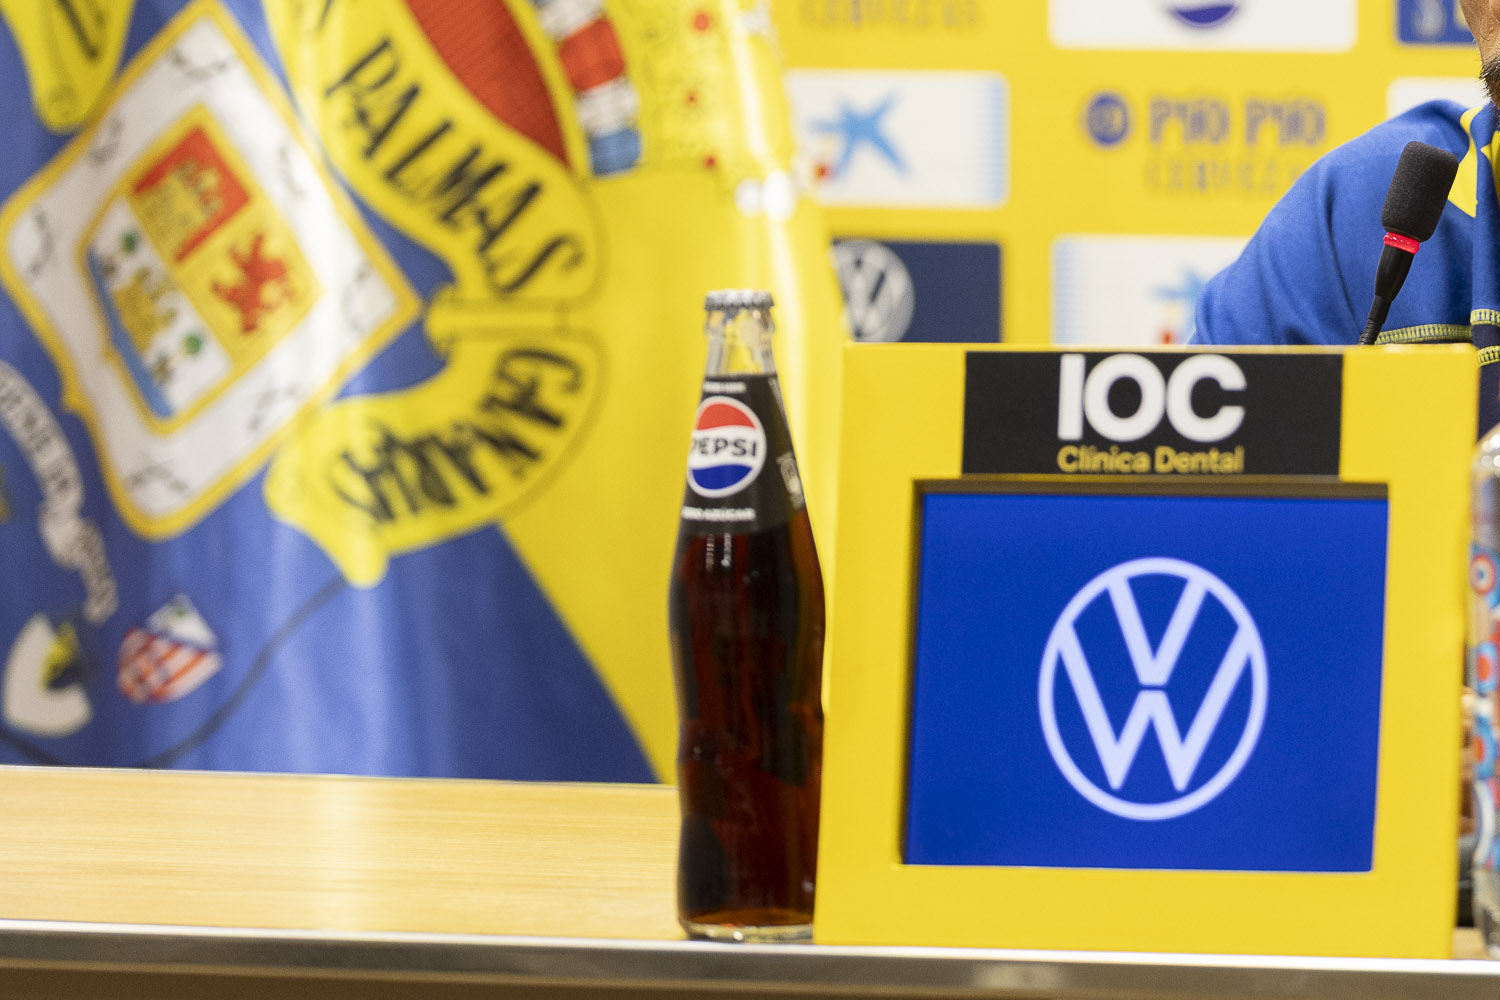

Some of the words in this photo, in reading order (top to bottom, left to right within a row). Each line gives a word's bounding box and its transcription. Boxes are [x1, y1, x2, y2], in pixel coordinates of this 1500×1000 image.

[325, 35, 585, 301] PALMAS
[1058, 353, 1247, 442] IOC
[1155, 446, 1245, 474] Dental
